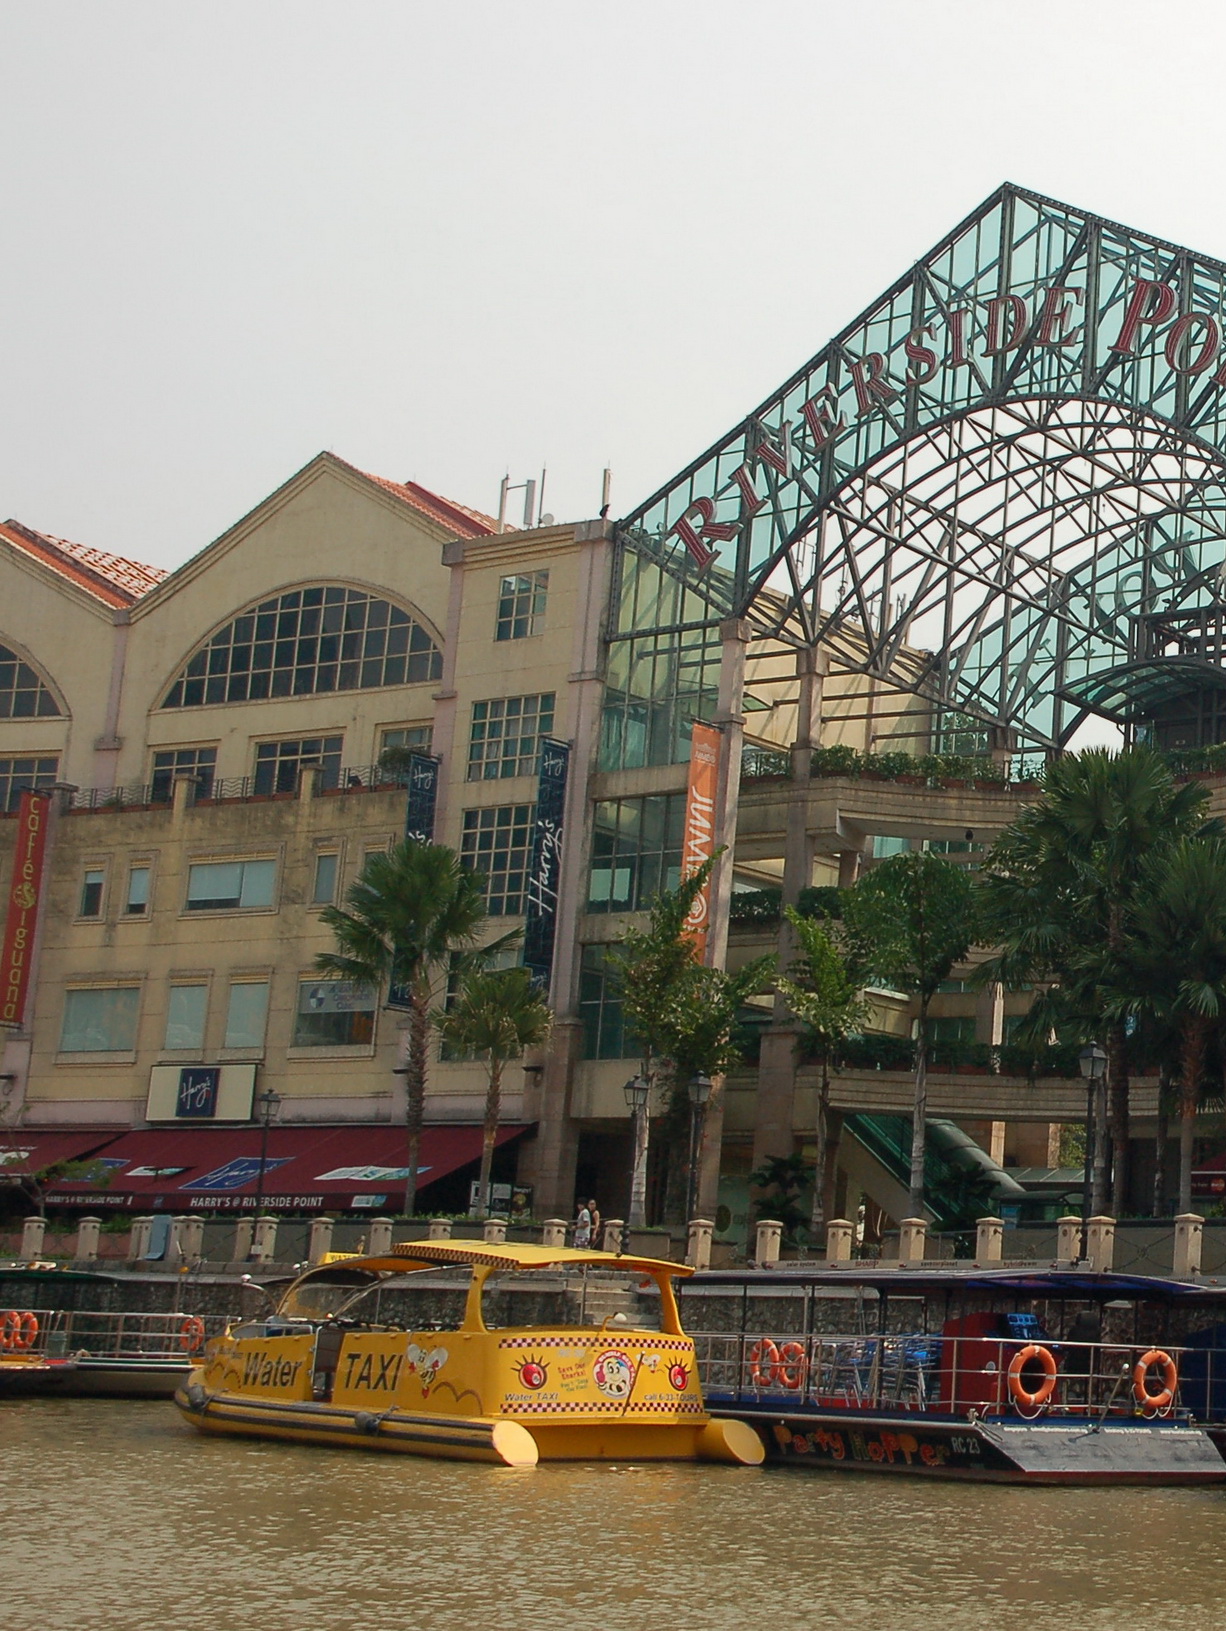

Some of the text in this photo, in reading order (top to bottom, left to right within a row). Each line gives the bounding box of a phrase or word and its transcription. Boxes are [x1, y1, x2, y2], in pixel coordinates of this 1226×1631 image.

[668, 284, 1087, 574] RIVERSIDE
[190, 1196, 231, 1207] HARRY'S
[293, 1196, 324, 1207] POINT
[243, 1352, 303, 1388] Water
[345, 1353, 404, 1391] TAXI
[505, 1392, 560, 1402] Water TAXI
[951, 1436, 981, 1455] RC 23
